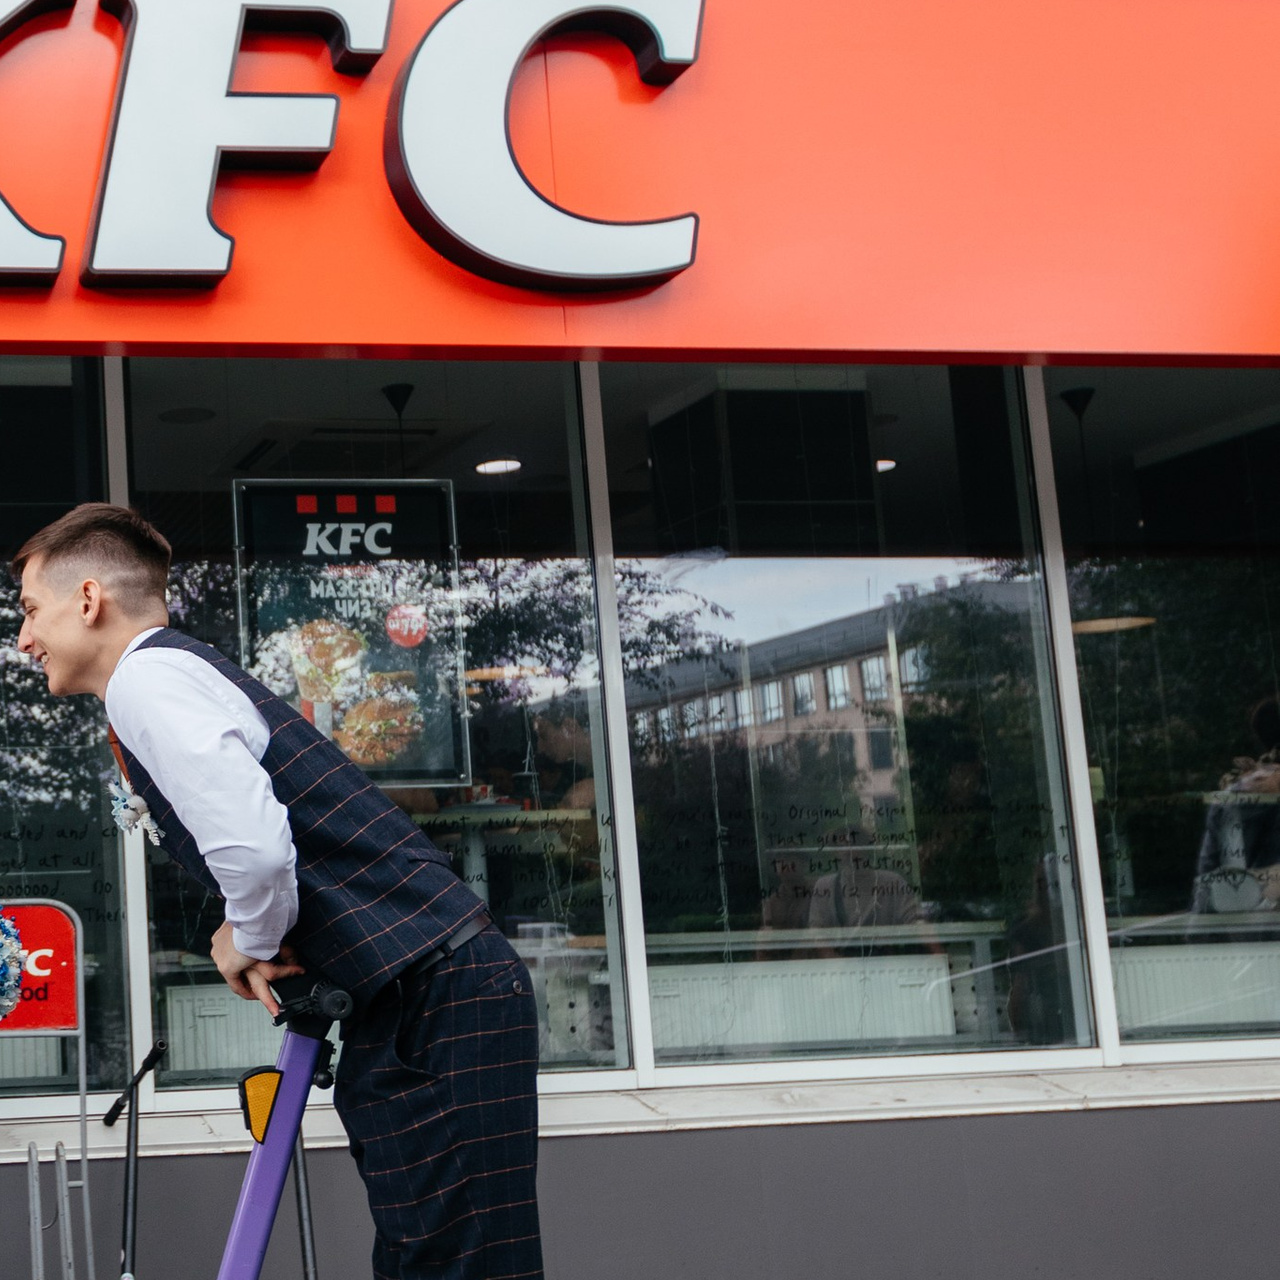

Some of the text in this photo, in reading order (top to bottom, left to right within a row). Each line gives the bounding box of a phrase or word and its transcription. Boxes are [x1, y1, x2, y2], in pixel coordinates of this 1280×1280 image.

[302, 522, 393, 556] KFC
[310, 579, 394, 599] МАЭСТРО
[788, 803, 847, 826] Original
[56, 823, 88, 839] and
[767, 831, 807, 846] that
[816, 829, 860, 852] great
[38, 853, 64, 868] at
[772, 858, 796, 872] the
[808, 857, 842, 872] best
[852, 856, 913, 876] tasting
